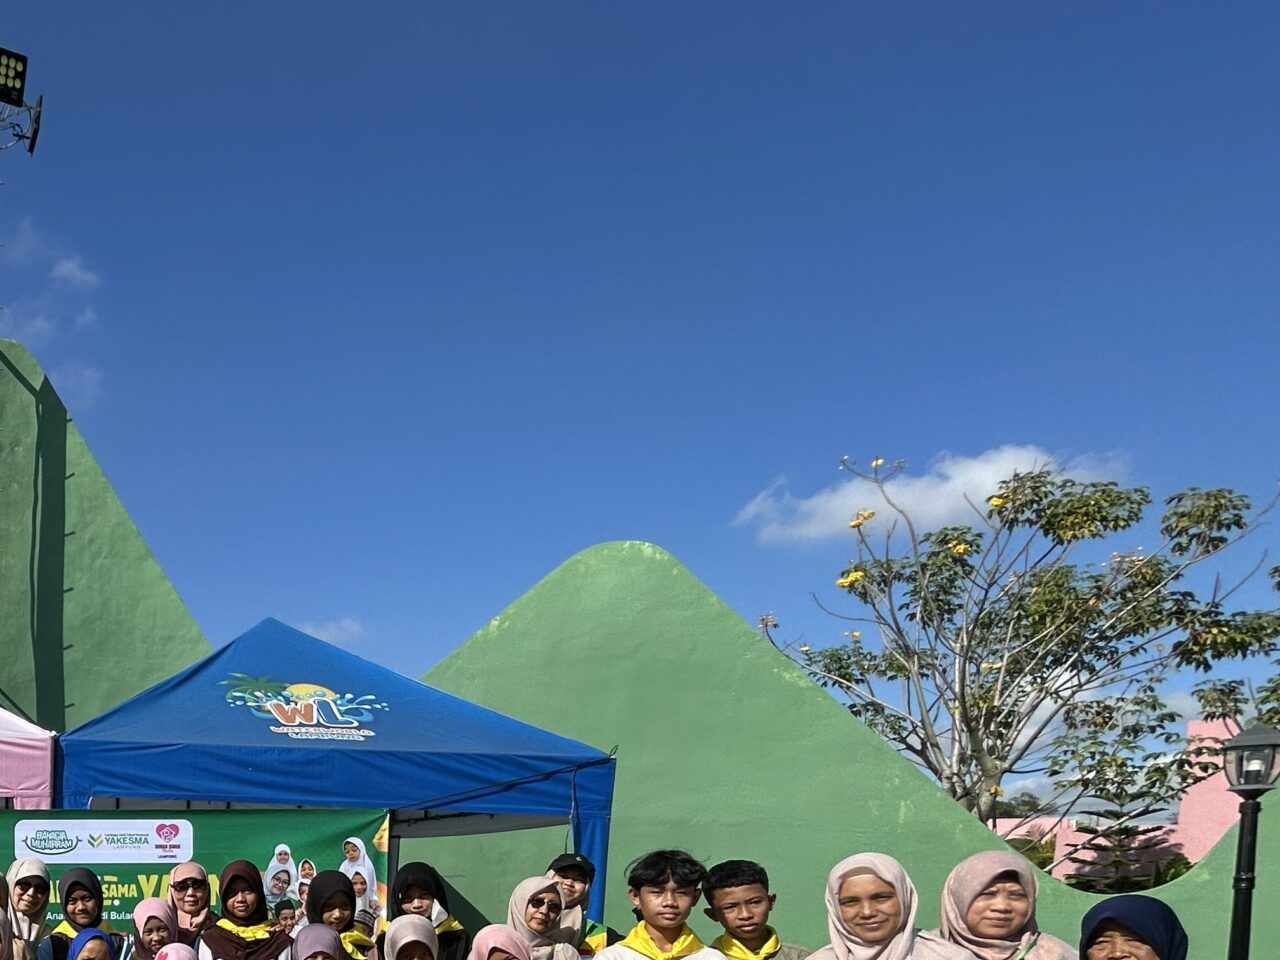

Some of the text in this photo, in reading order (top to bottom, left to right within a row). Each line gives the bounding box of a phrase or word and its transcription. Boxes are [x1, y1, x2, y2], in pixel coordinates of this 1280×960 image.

[268, 697, 358, 727] WL
[36, 830, 68, 841] BAHAGIA
[31, 839, 73, 850] MUHARRAM
